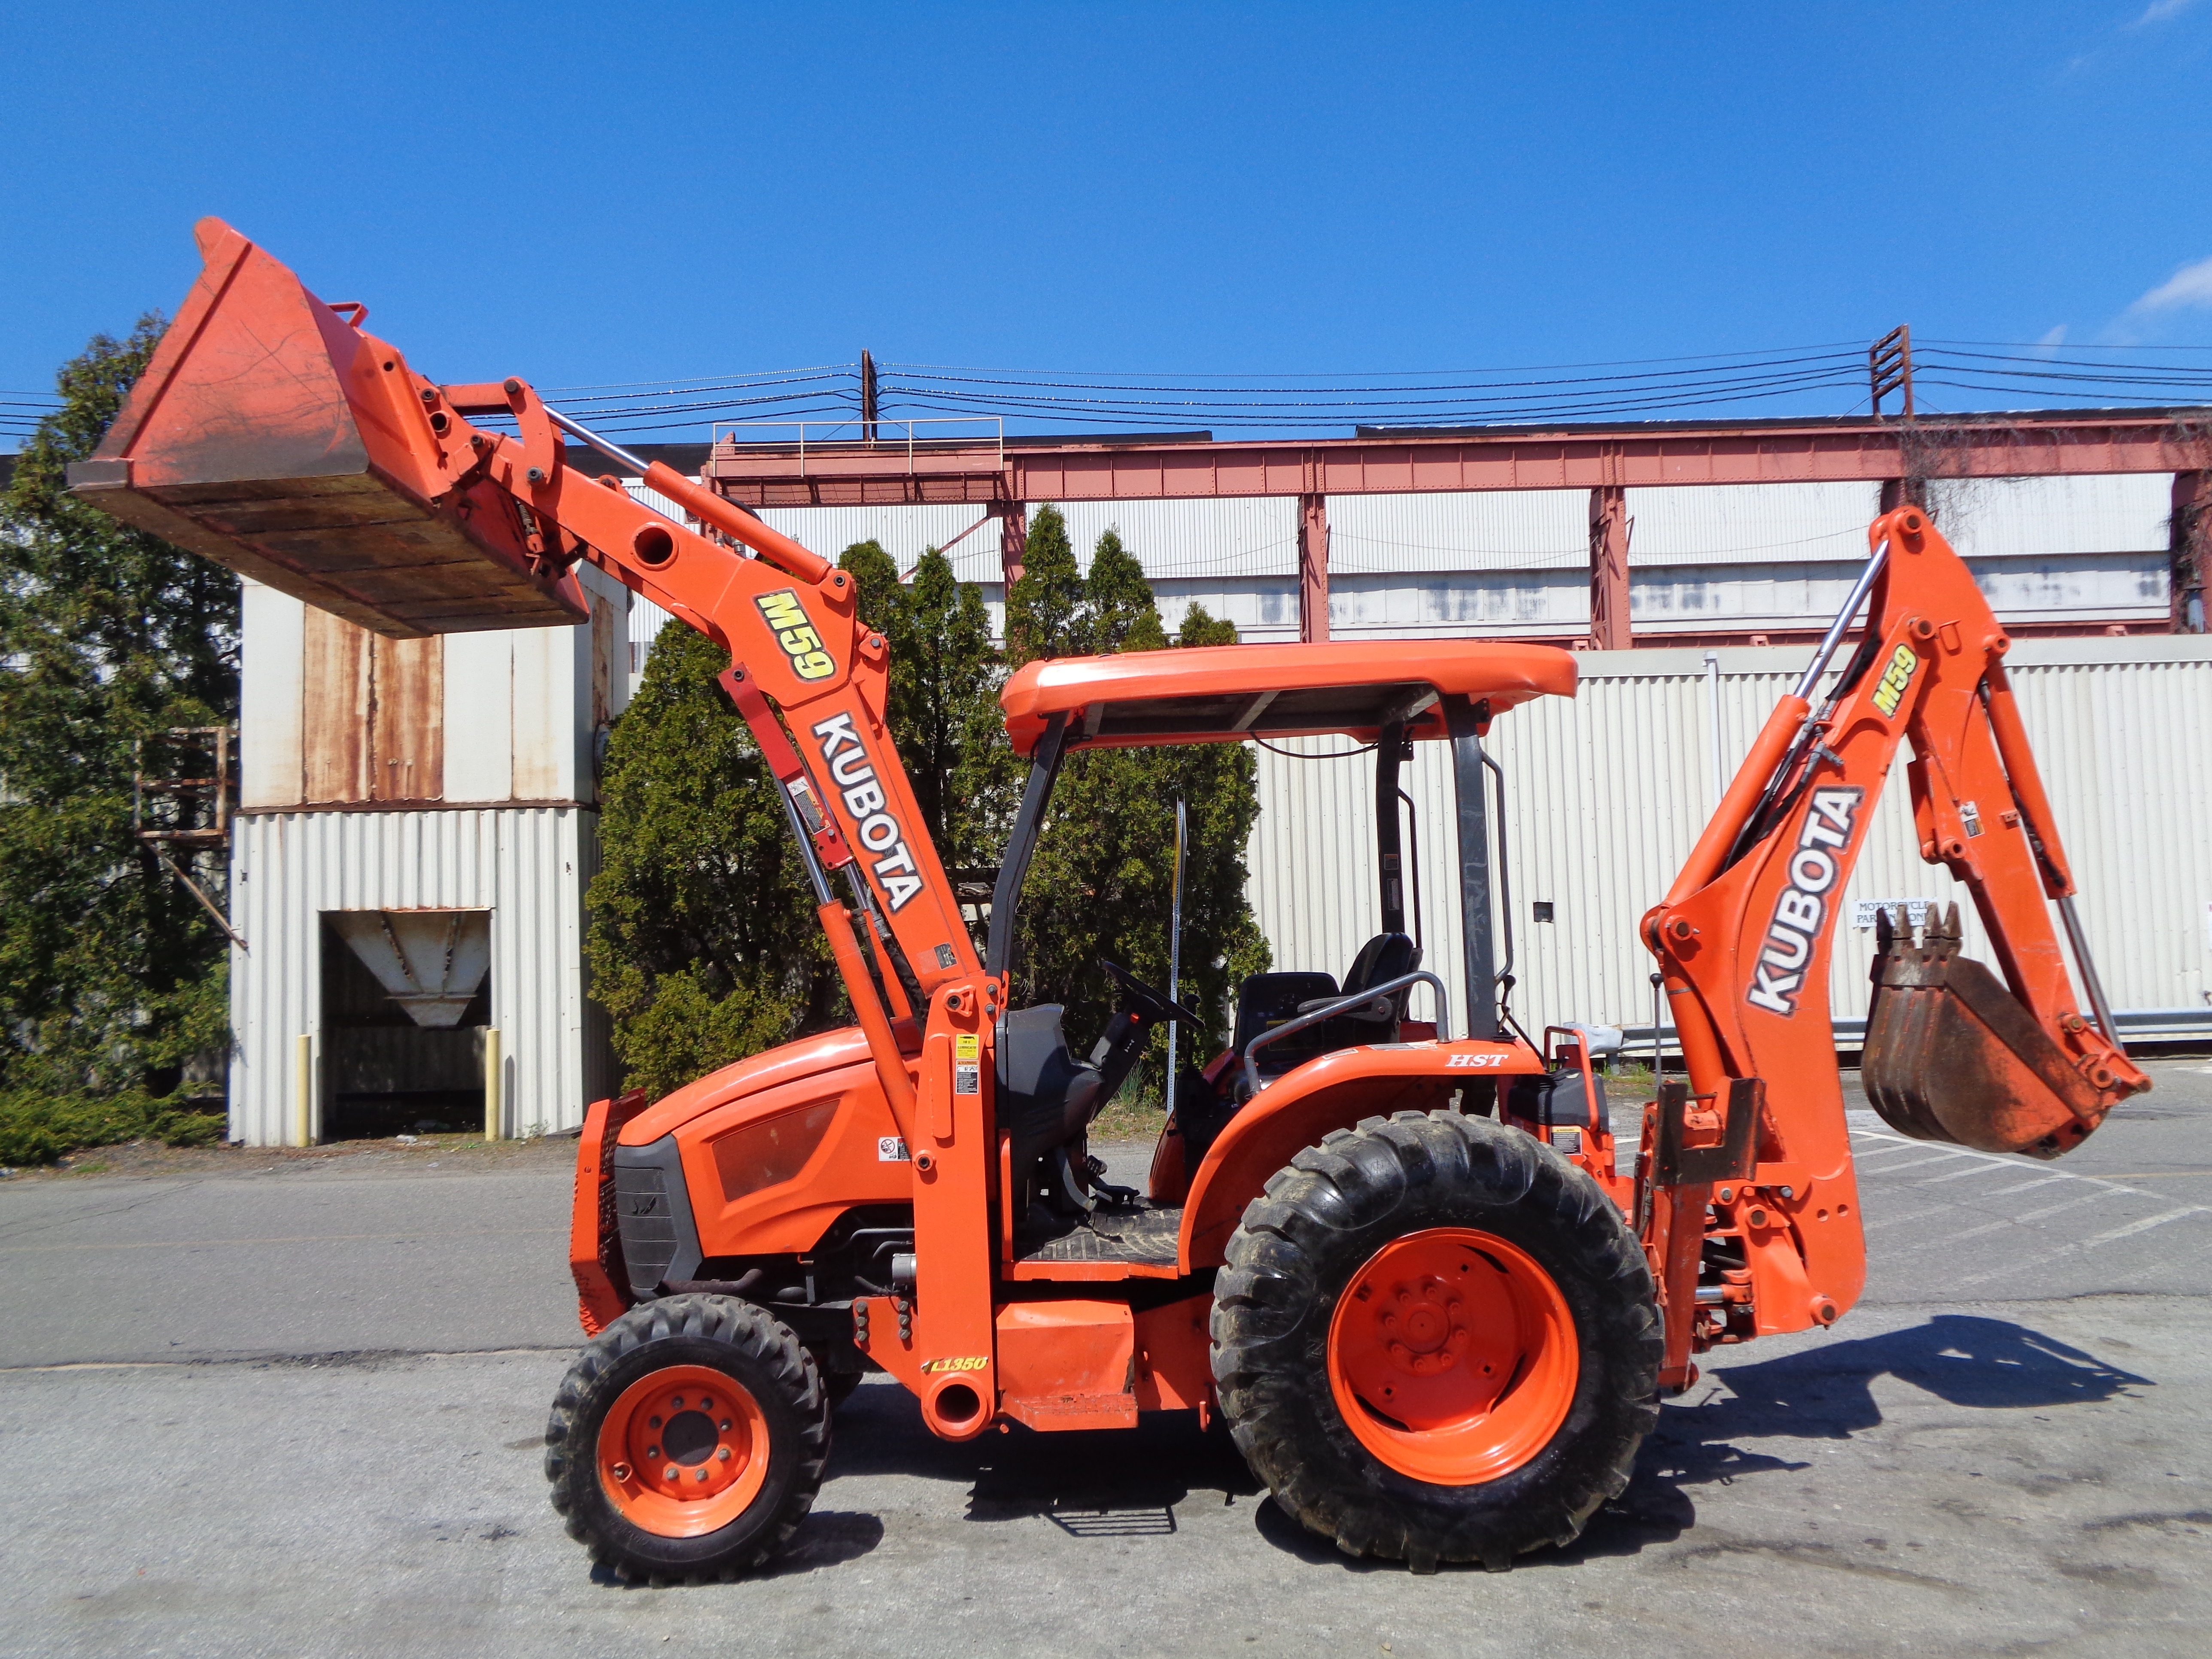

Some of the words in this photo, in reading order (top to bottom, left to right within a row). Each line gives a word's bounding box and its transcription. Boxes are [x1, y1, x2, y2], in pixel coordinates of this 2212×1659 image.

[757, 592, 835, 679] M59
[1872, 644, 1917, 717] M59
[813, 713, 922, 912] KUBOTA
[1749, 790, 1860, 1014] KUBOTA
[1857, 914, 1896, 923] PARN
[1445, 1054, 1509, 1067] HST
